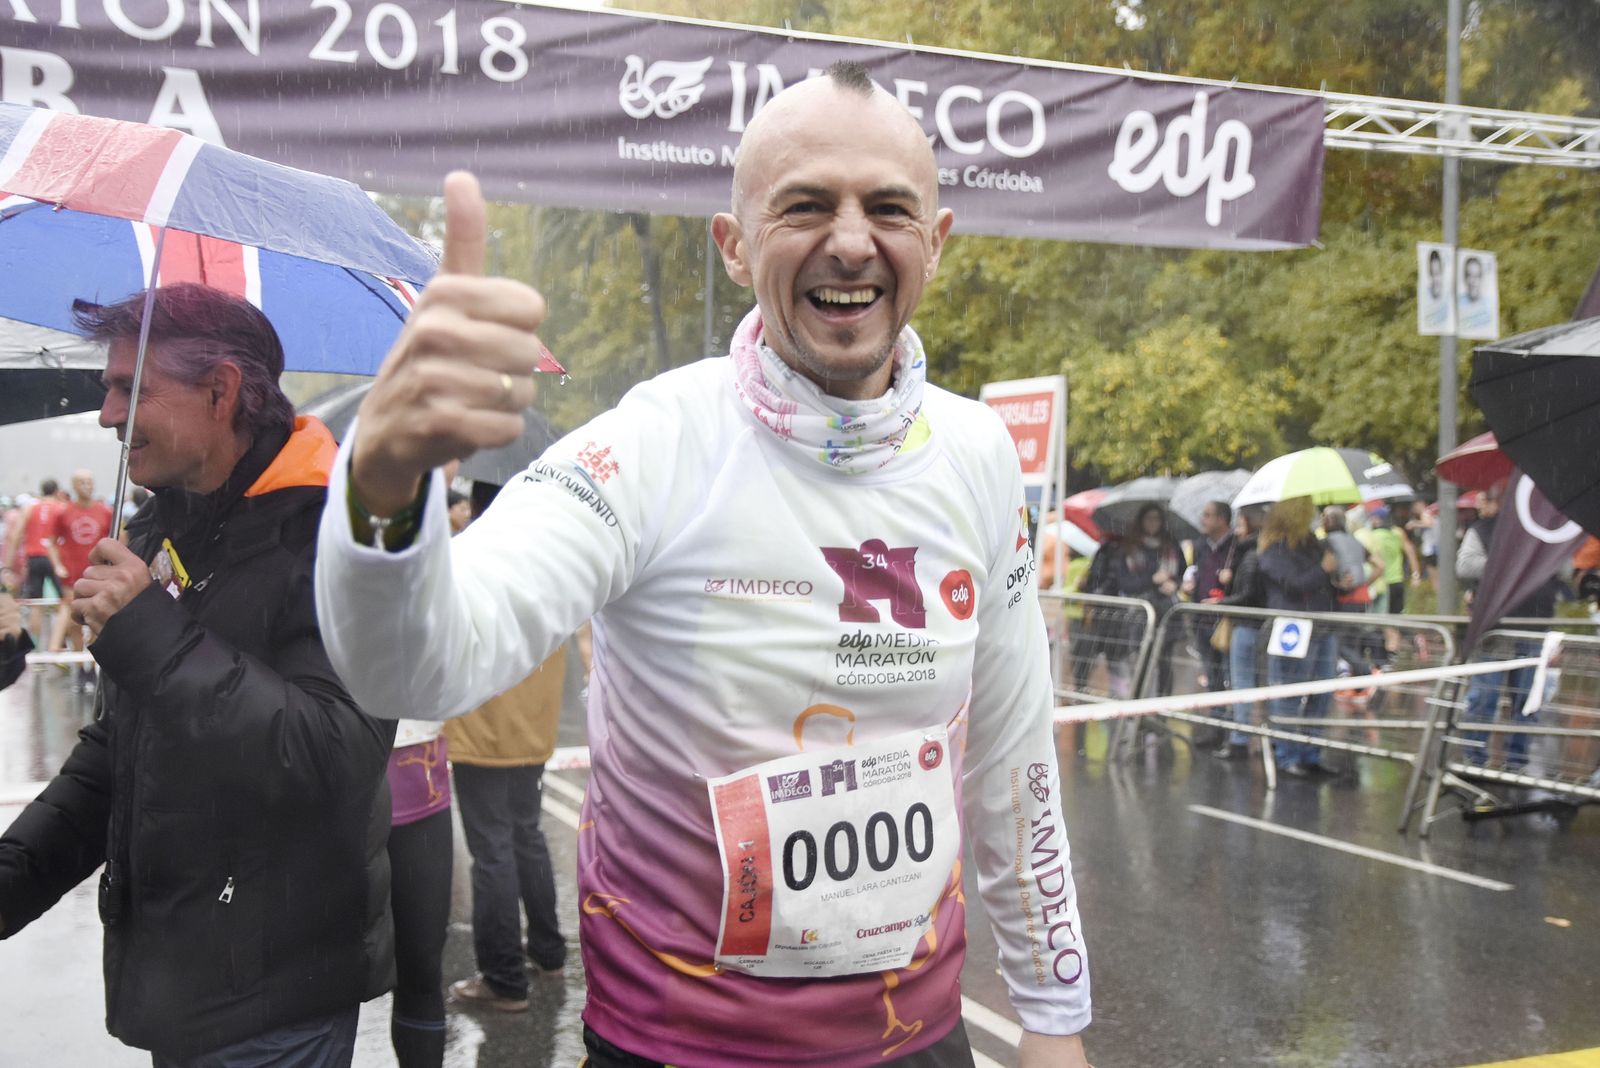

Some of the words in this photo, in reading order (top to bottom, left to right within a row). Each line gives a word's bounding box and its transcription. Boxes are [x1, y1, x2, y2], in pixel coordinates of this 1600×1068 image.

[309, 0, 529, 83] 2018
[727, 61, 1046, 158] IECO
[618, 136, 715, 166] Instituto
[1108, 91, 1256, 227] edp
[963, 165, 1044, 193] Córdoba
[861, 553, 888, 569] 34
[729, 579, 813, 595] IMDECO
[951, 584, 969, 605] edp
[838, 629, 872, 652] edp
[835, 649, 937, 668] MARATÓN
[836, 671, 906, 686] CÓRDOBA
[907, 668, 936, 682] 2018
[877, 750, 910, 763] MEDIA
[833, 763, 843, 772] 34
[862, 761, 911, 779] MARATÓN
[771, 785, 810, 800] IMDECO
[783, 802, 934, 891] 0000
[820, 888, 855, 901] MANUEL
[857, 882, 878, 893] LARA
[880, 872, 922, 888] CANTIZANI
[1031, 808, 1082, 985] IMDECO
[856, 919, 912, 939] Cruzcampo
